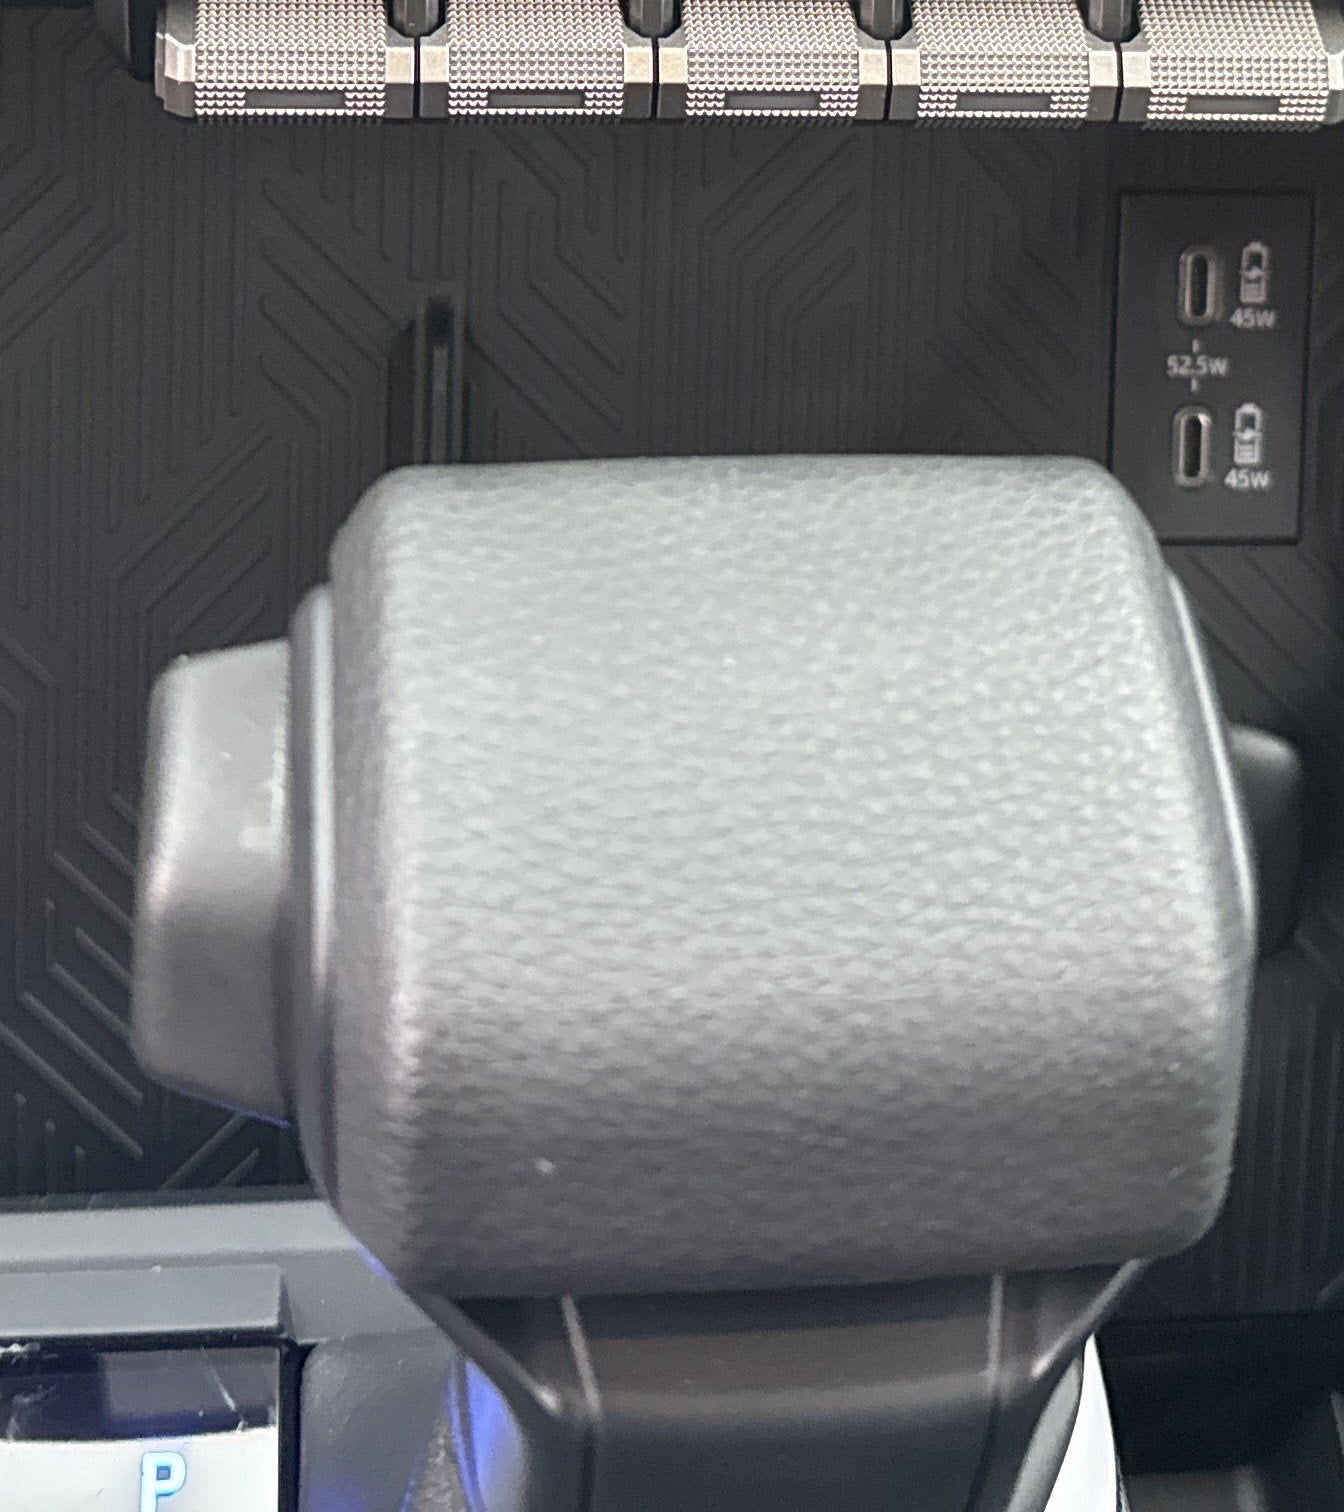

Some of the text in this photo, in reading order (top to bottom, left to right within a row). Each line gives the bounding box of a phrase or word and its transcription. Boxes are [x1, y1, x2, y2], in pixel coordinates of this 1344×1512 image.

[1229, 308, 1278, 329] 45W
[1166, 354, 1229, 377] 52.5W
[1224, 469, 1272, 490] 45W
[140, 1451, 187, 1512] P
